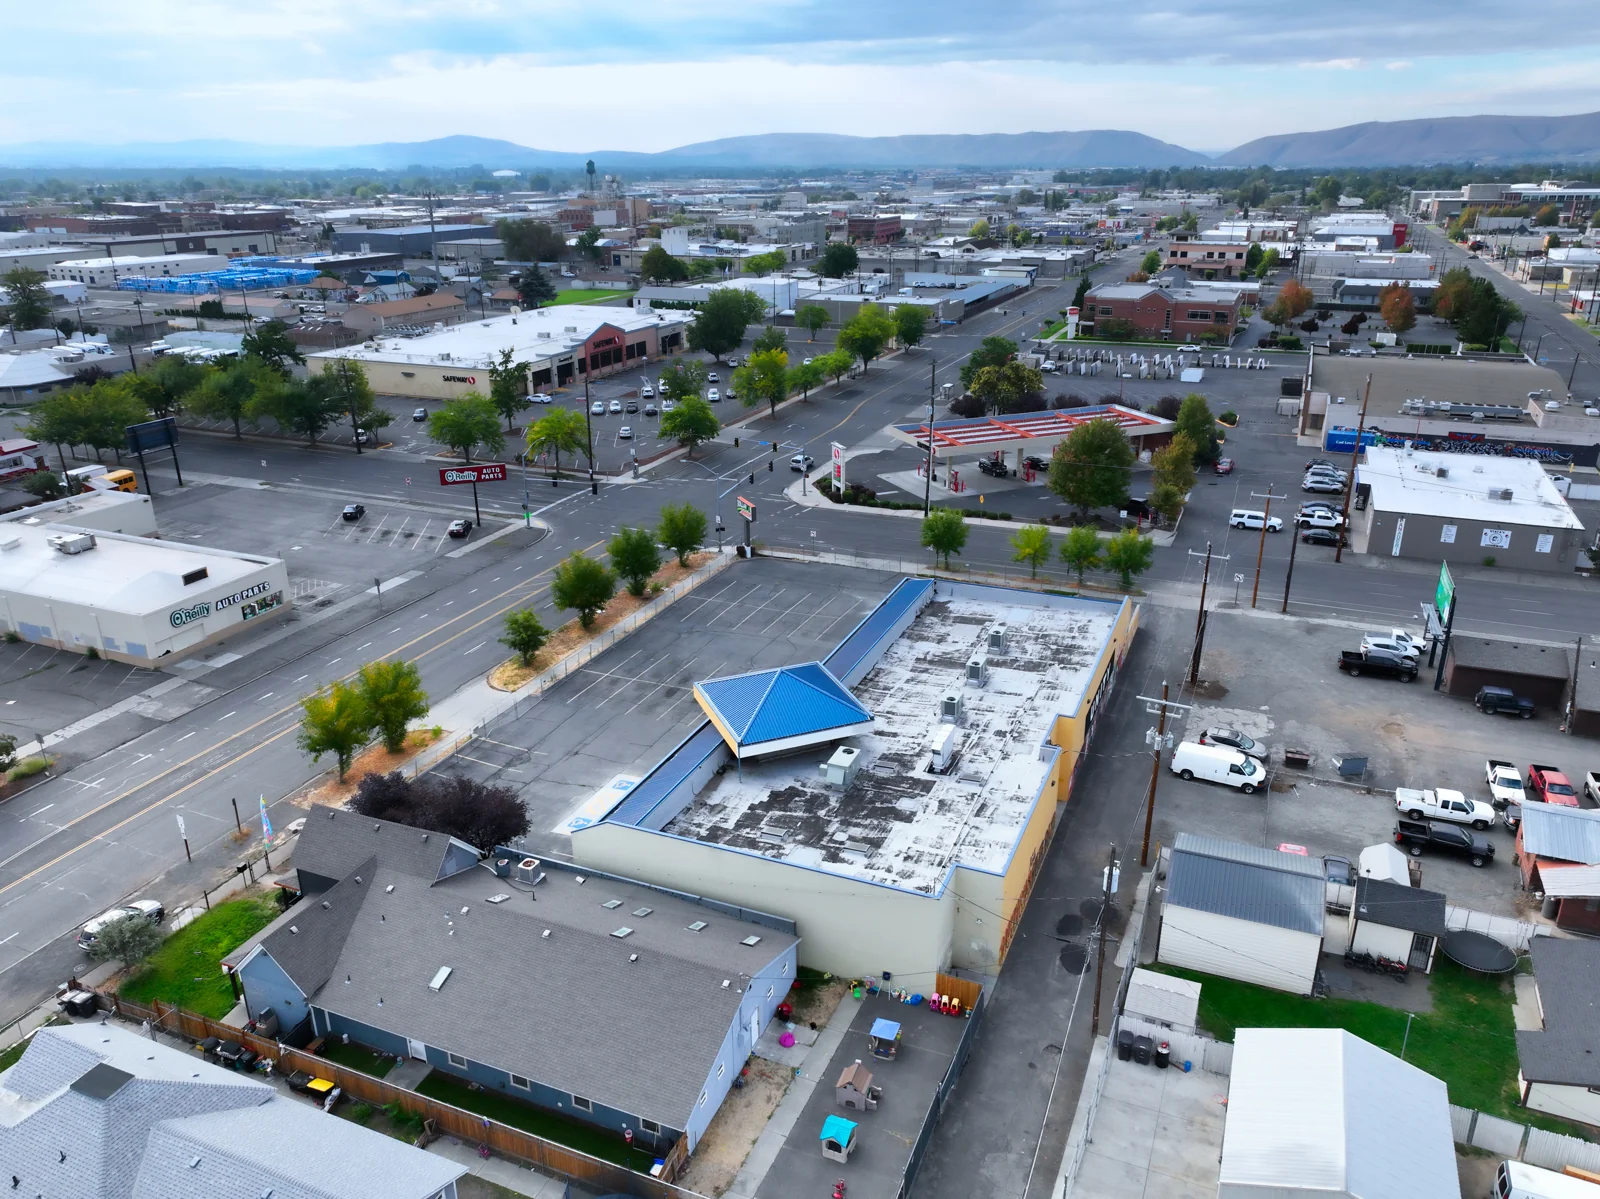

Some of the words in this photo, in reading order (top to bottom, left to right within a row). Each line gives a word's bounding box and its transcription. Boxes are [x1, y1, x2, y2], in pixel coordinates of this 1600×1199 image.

[442, 375, 468, 383] SAFEWAY
[445, 470, 477, 482] O'Reilly
[170, 602, 211, 628] O'Reilly
[216, 594, 241, 611] AUTO
[242, 581, 270, 600] PARTS
